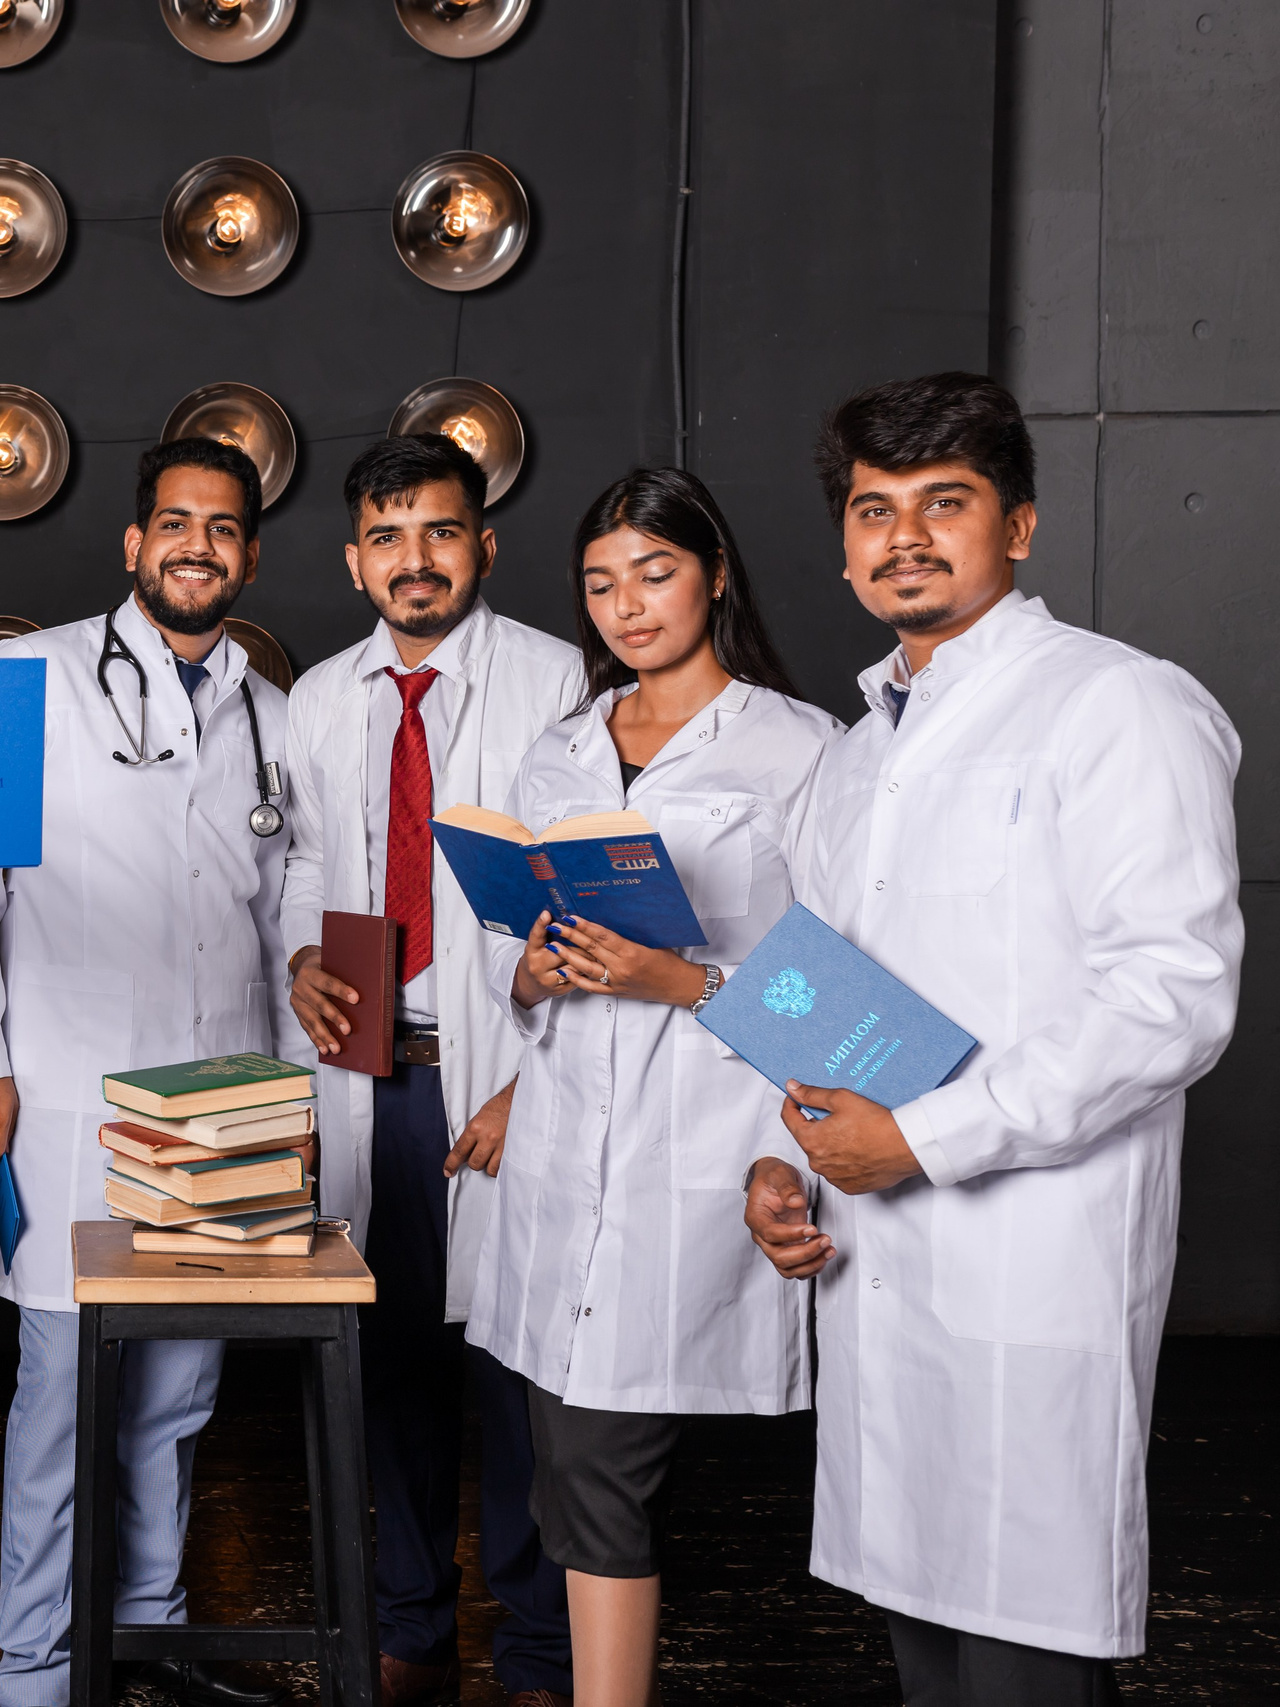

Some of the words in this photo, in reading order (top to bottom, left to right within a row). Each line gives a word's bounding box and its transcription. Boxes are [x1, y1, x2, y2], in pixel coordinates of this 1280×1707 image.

[572, 880, 610, 888] ТОМАС
[612, 878, 641, 886] ВУЛФ
[611, 858, 661, 871] США
[824, 1011, 881, 1077] ДИПЛОМ
[849, 1068, 858, 1076] О
[855, 1036, 886, 1071] ВЫСШЕМ
[855, 1038, 903, 1091] ОБРАЗОВАНИИ
